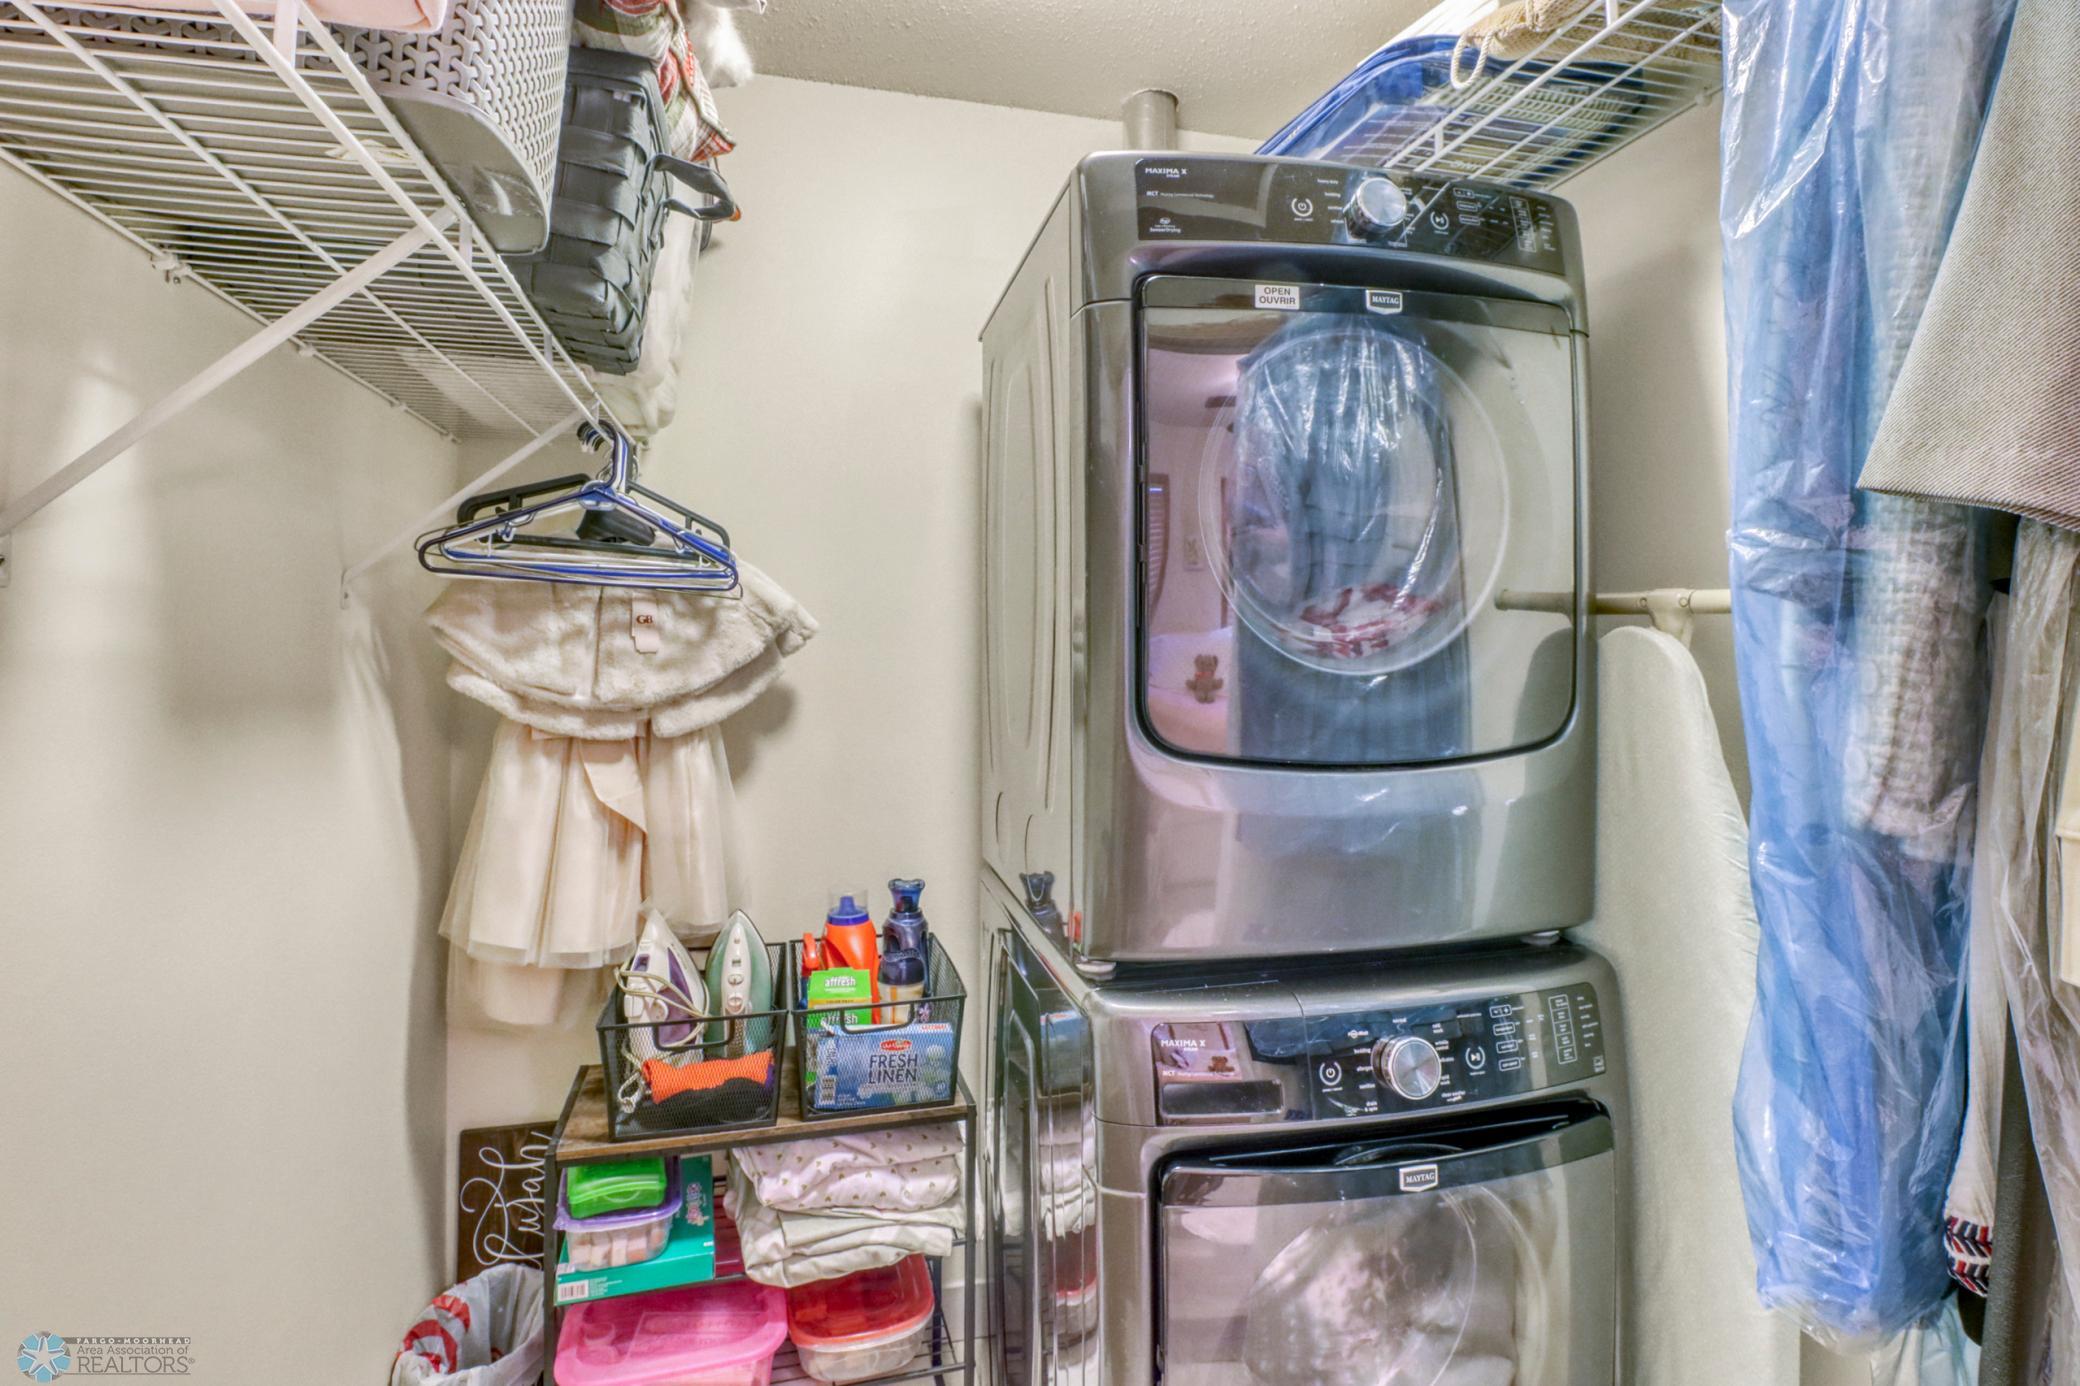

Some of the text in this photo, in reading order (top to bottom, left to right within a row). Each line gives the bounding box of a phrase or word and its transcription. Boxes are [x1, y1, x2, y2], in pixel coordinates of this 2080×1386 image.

[1145, 167, 1179, 175] MAXIMA
[1263, 286, 1291, 295] OPEN
[1258, 295, 1296, 305] OUVRIR
[1372, 295, 1400, 305] MAYTAG
[1161, 1039, 1197, 1047] MAXIMA
[870, 1053, 918, 1068] FRESH
[868, 1069, 918, 1084] LINEN
[1406, 1172, 1435, 1183] MAYTAG
